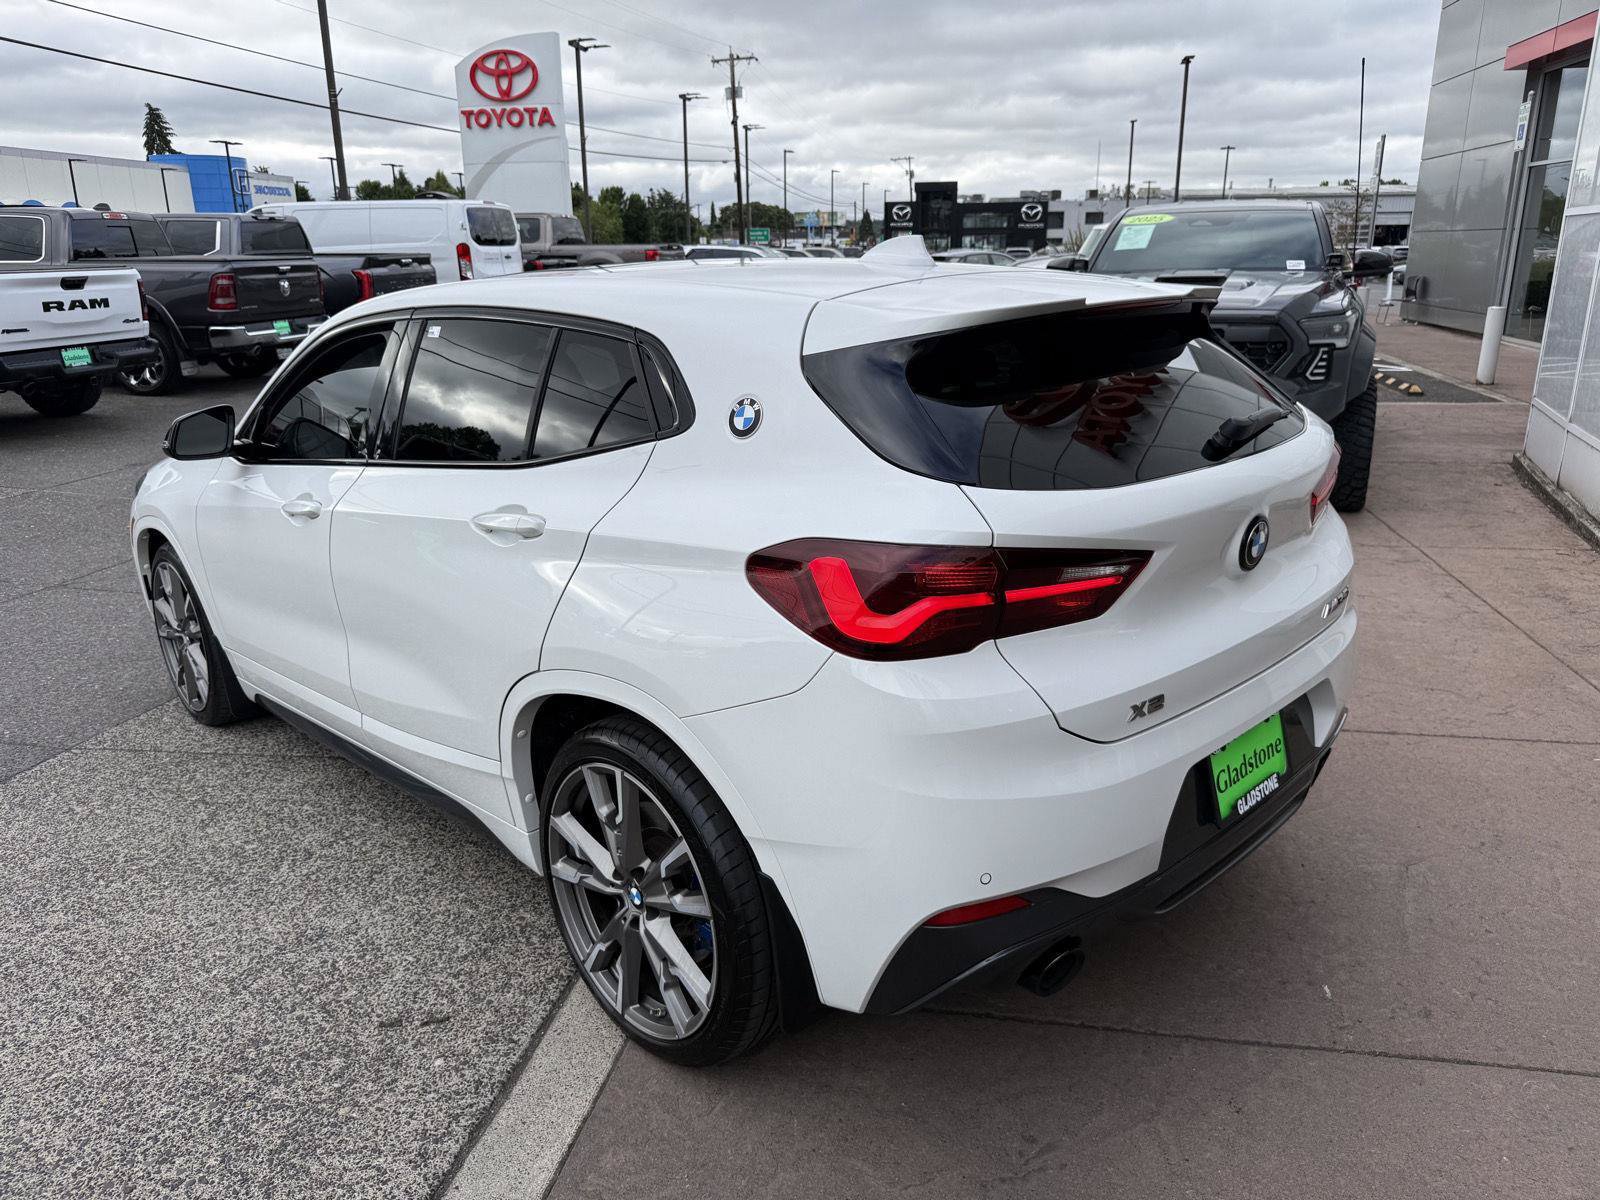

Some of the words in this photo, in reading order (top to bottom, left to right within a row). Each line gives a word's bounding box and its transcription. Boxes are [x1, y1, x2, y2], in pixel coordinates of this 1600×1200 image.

[461, 107, 556, 129] TOYOTA
[42, 297, 110, 312] RAM
[1127, 694, 1164, 722] X2
[1217, 738, 1281, 793] Gladstone
[1237, 773, 1280, 815] GLADSTONE
